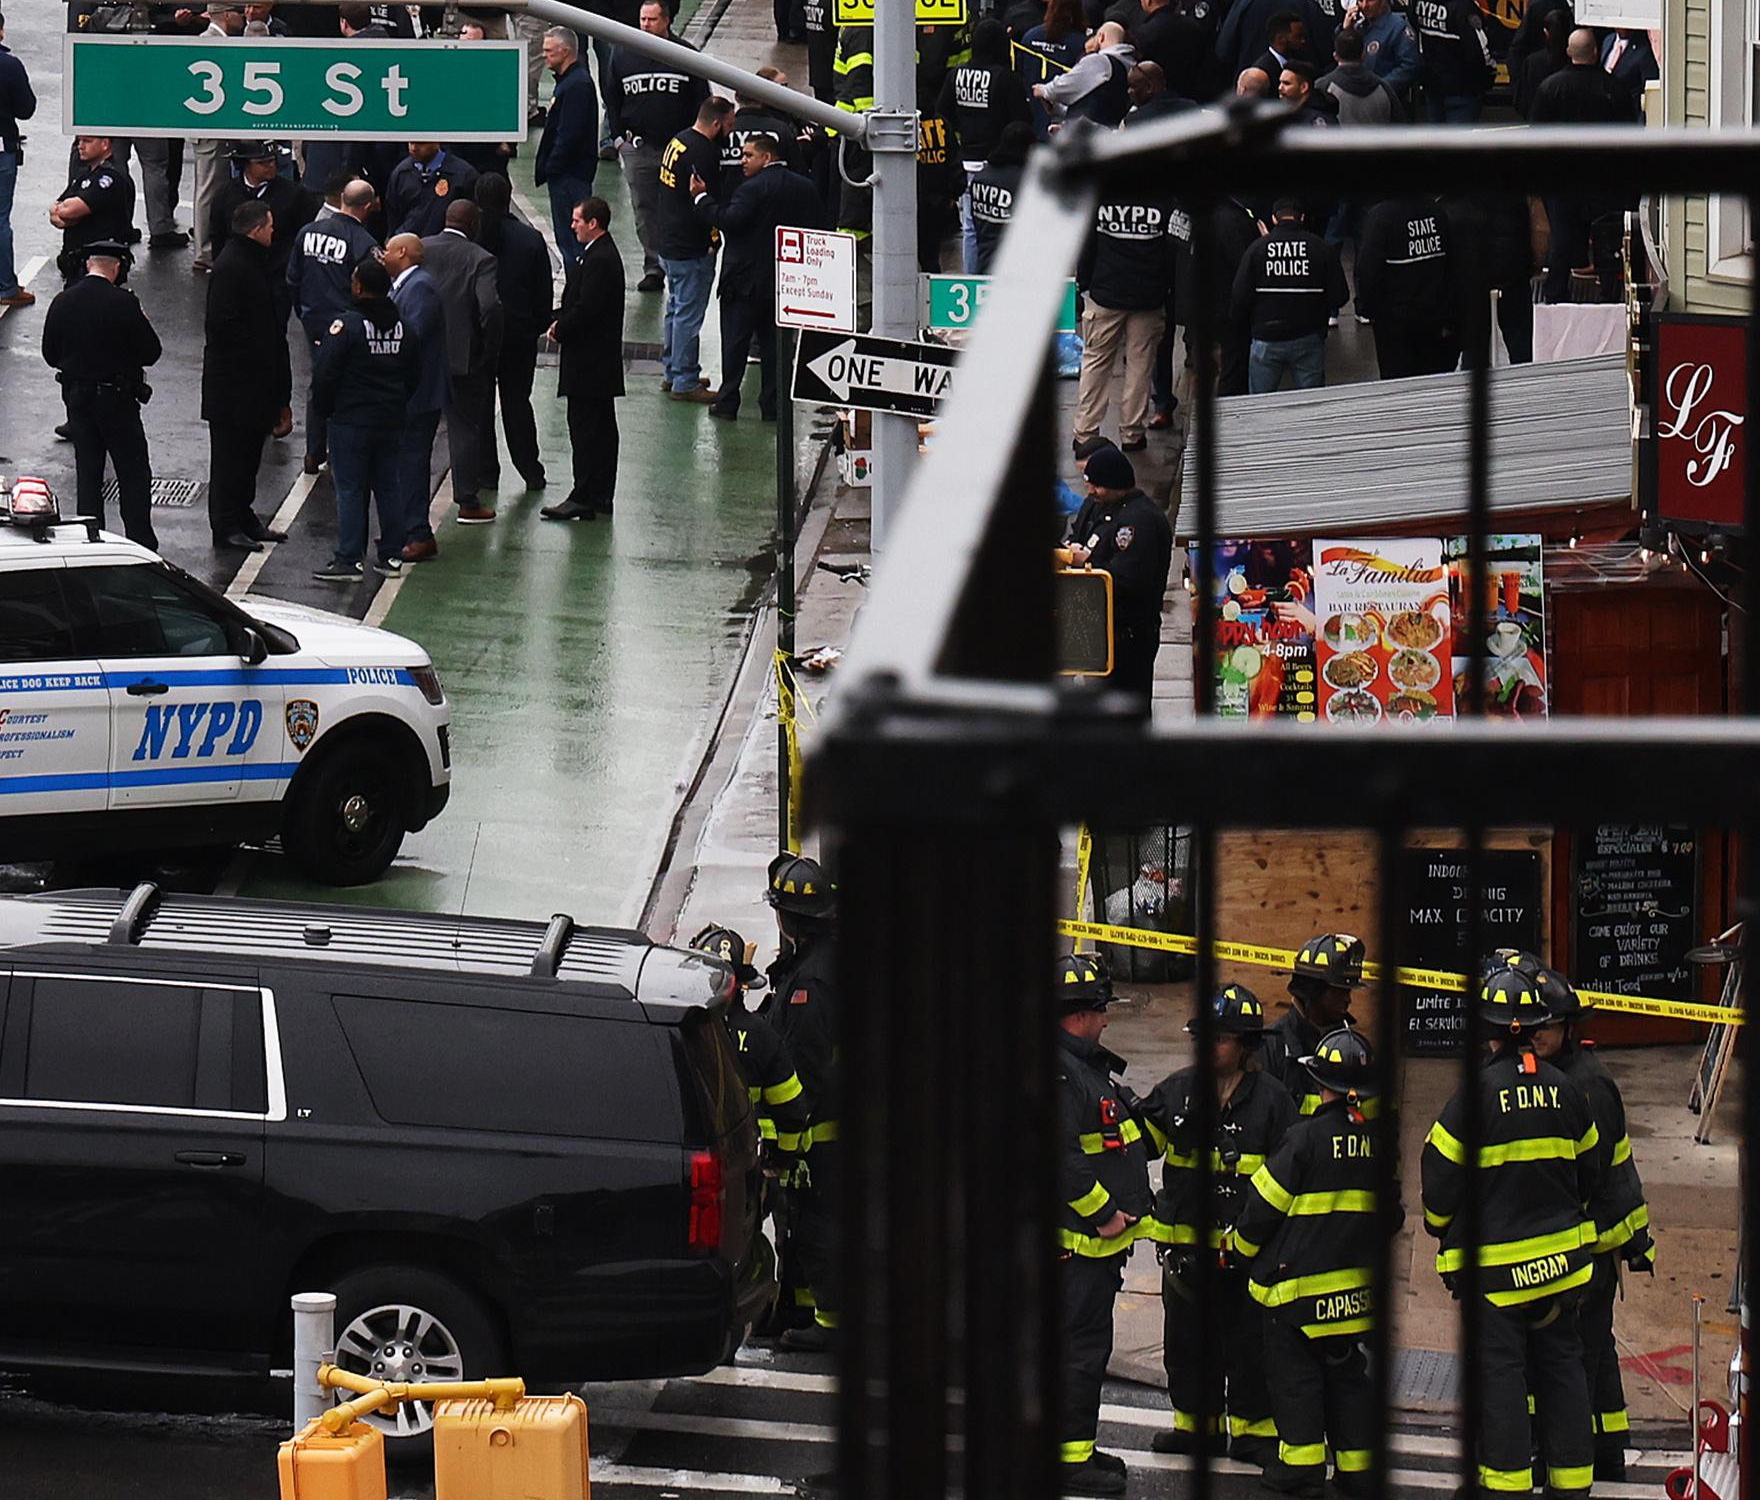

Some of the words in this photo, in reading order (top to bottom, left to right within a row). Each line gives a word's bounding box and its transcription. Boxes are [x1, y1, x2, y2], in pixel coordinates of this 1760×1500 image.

[183, 60, 284, 116] 35
[321, 62, 409, 118] St
[623, 77, 680, 96] POLICE
[1097, 205, 1161, 226] NYPD
[1406, 216, 1437, 238] STATE
[303, 232, 348, 260] NYPD
[806, 235, 827, 246] Truck
[1267, 240, 1307, 258] STATE
[1408, 235, 1441, 257] POLICE
[806, 246, 836, 260] Loading
[806, 256, 823, 269] Only
[1266, 259, 1310, 277] POLICE
[780, 285, 807, 298] Except
[807, 287, 834, 301] Sunday
[368, 340, 401, 355] TARU
[828, 354, 885, 386] ONE
[914, 365, 953, 396] WA
[1326, 559, 1348, 577] La
[1346, 557, 1435, 585] Familia
[1328, 602, 1352, 612] BAR
[1355, 601, 1432, 613] RESTAURANT
[1261, 643, 1308, 660] 4-8pm
[21, 678, 43, 689] DOG
[46, 676, 72, 688] KEEP
[74, 675, 102, 687] BACK
[350, 667, 397, 685] POLICE
[1280, 681, 1313, 691] Cocktails
[132, 699, 264, 761] NYPD
[1410, 909, 1444, 925] MAX
[1614, 923, 1641, 936] ENJOY
[1650, 923, 1669, 935] OUR
[1617, 937, 1660, 952] VARIETY
[1500, 1085, 1561, 1113] F.D.N.Y.
[1511, 1253, 1569, 1288] INGRAM
